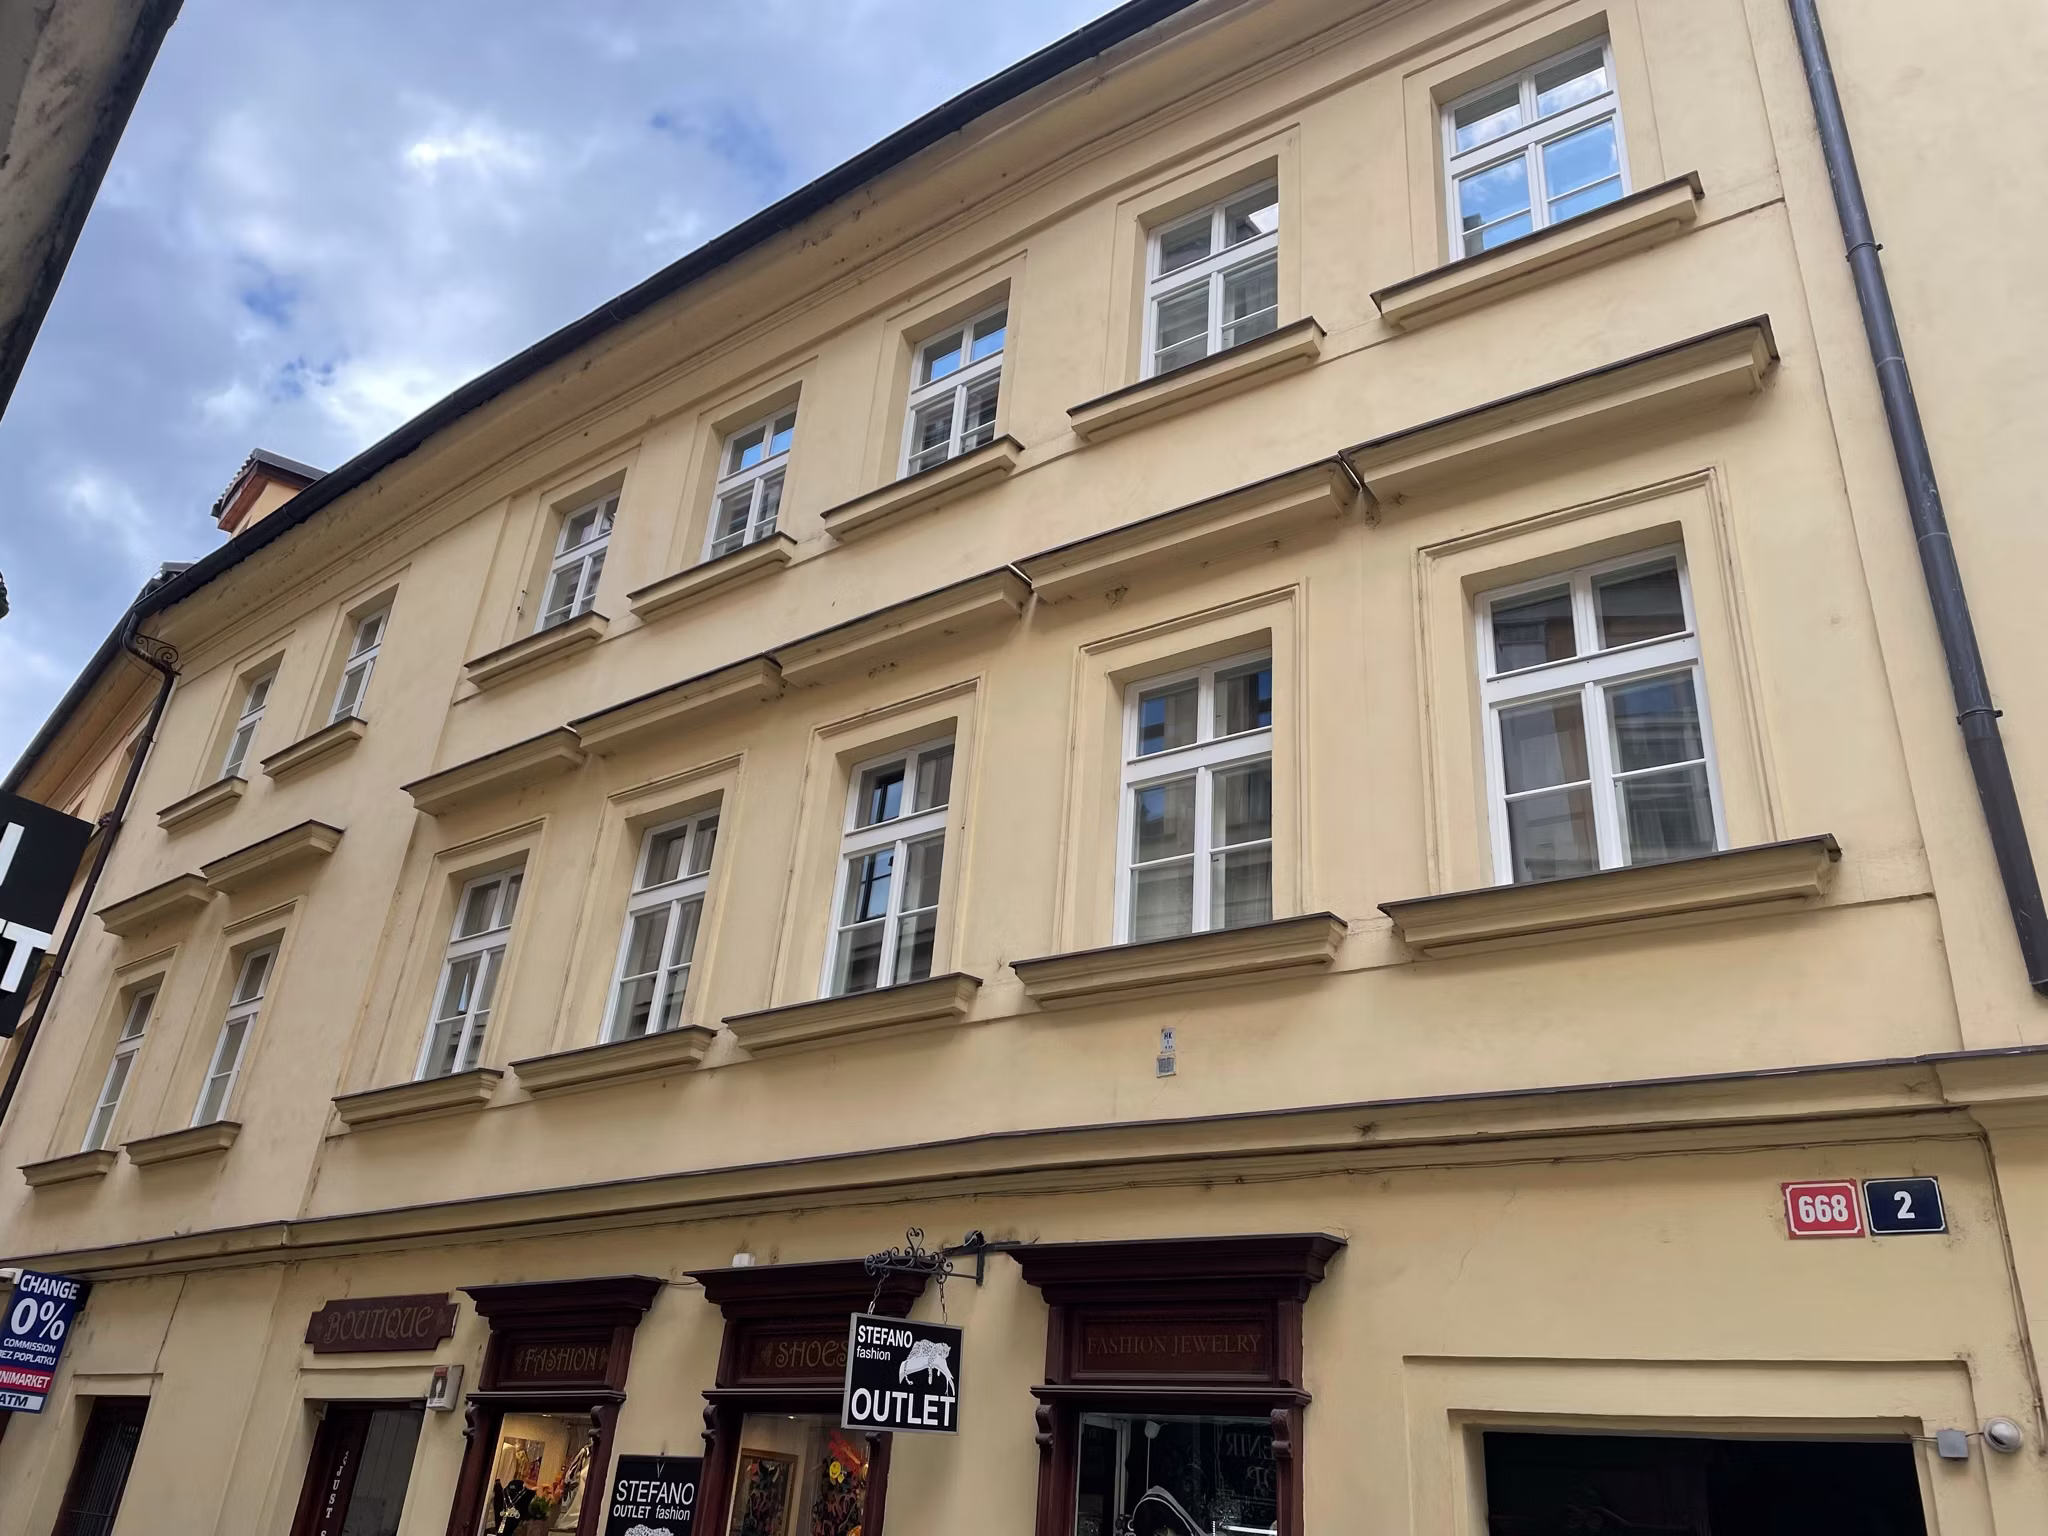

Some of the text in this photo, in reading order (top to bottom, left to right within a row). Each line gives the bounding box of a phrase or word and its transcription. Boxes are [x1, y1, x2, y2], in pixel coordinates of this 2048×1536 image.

[1798, 1194, 1848, 1224] 668
[1893, 1190, 1916, 1220] 2
[20, 1274, 80, 1300] CHANGE
[10, 1297, 66, 1340] 0%
[323, 1305, 435, 1345] BOUTIQUE
[3, 1338, 56, 1354] COMMISSION
[857, 1324, 913, 1349] STEFANO
[1087, 1333, 1261, 1357] FASHION JEWELRY
[0, 1349, 56, 1366] EZ POPLATKU
[524, 1347, 598, 1376] FASHION
[856, 1346, 891, 1361] fashion
[0, 1369, 51, 1389] NIMARKET
[0, 1393, 29, 1407] ATM
[851, 1387, 956, 1428] OUTLET
[325, 1465, 344, 1519] JUST
[616, 1480, 695, 1505] STEFANO
[613, 1504, 690, 1521] OUTLET fashion
